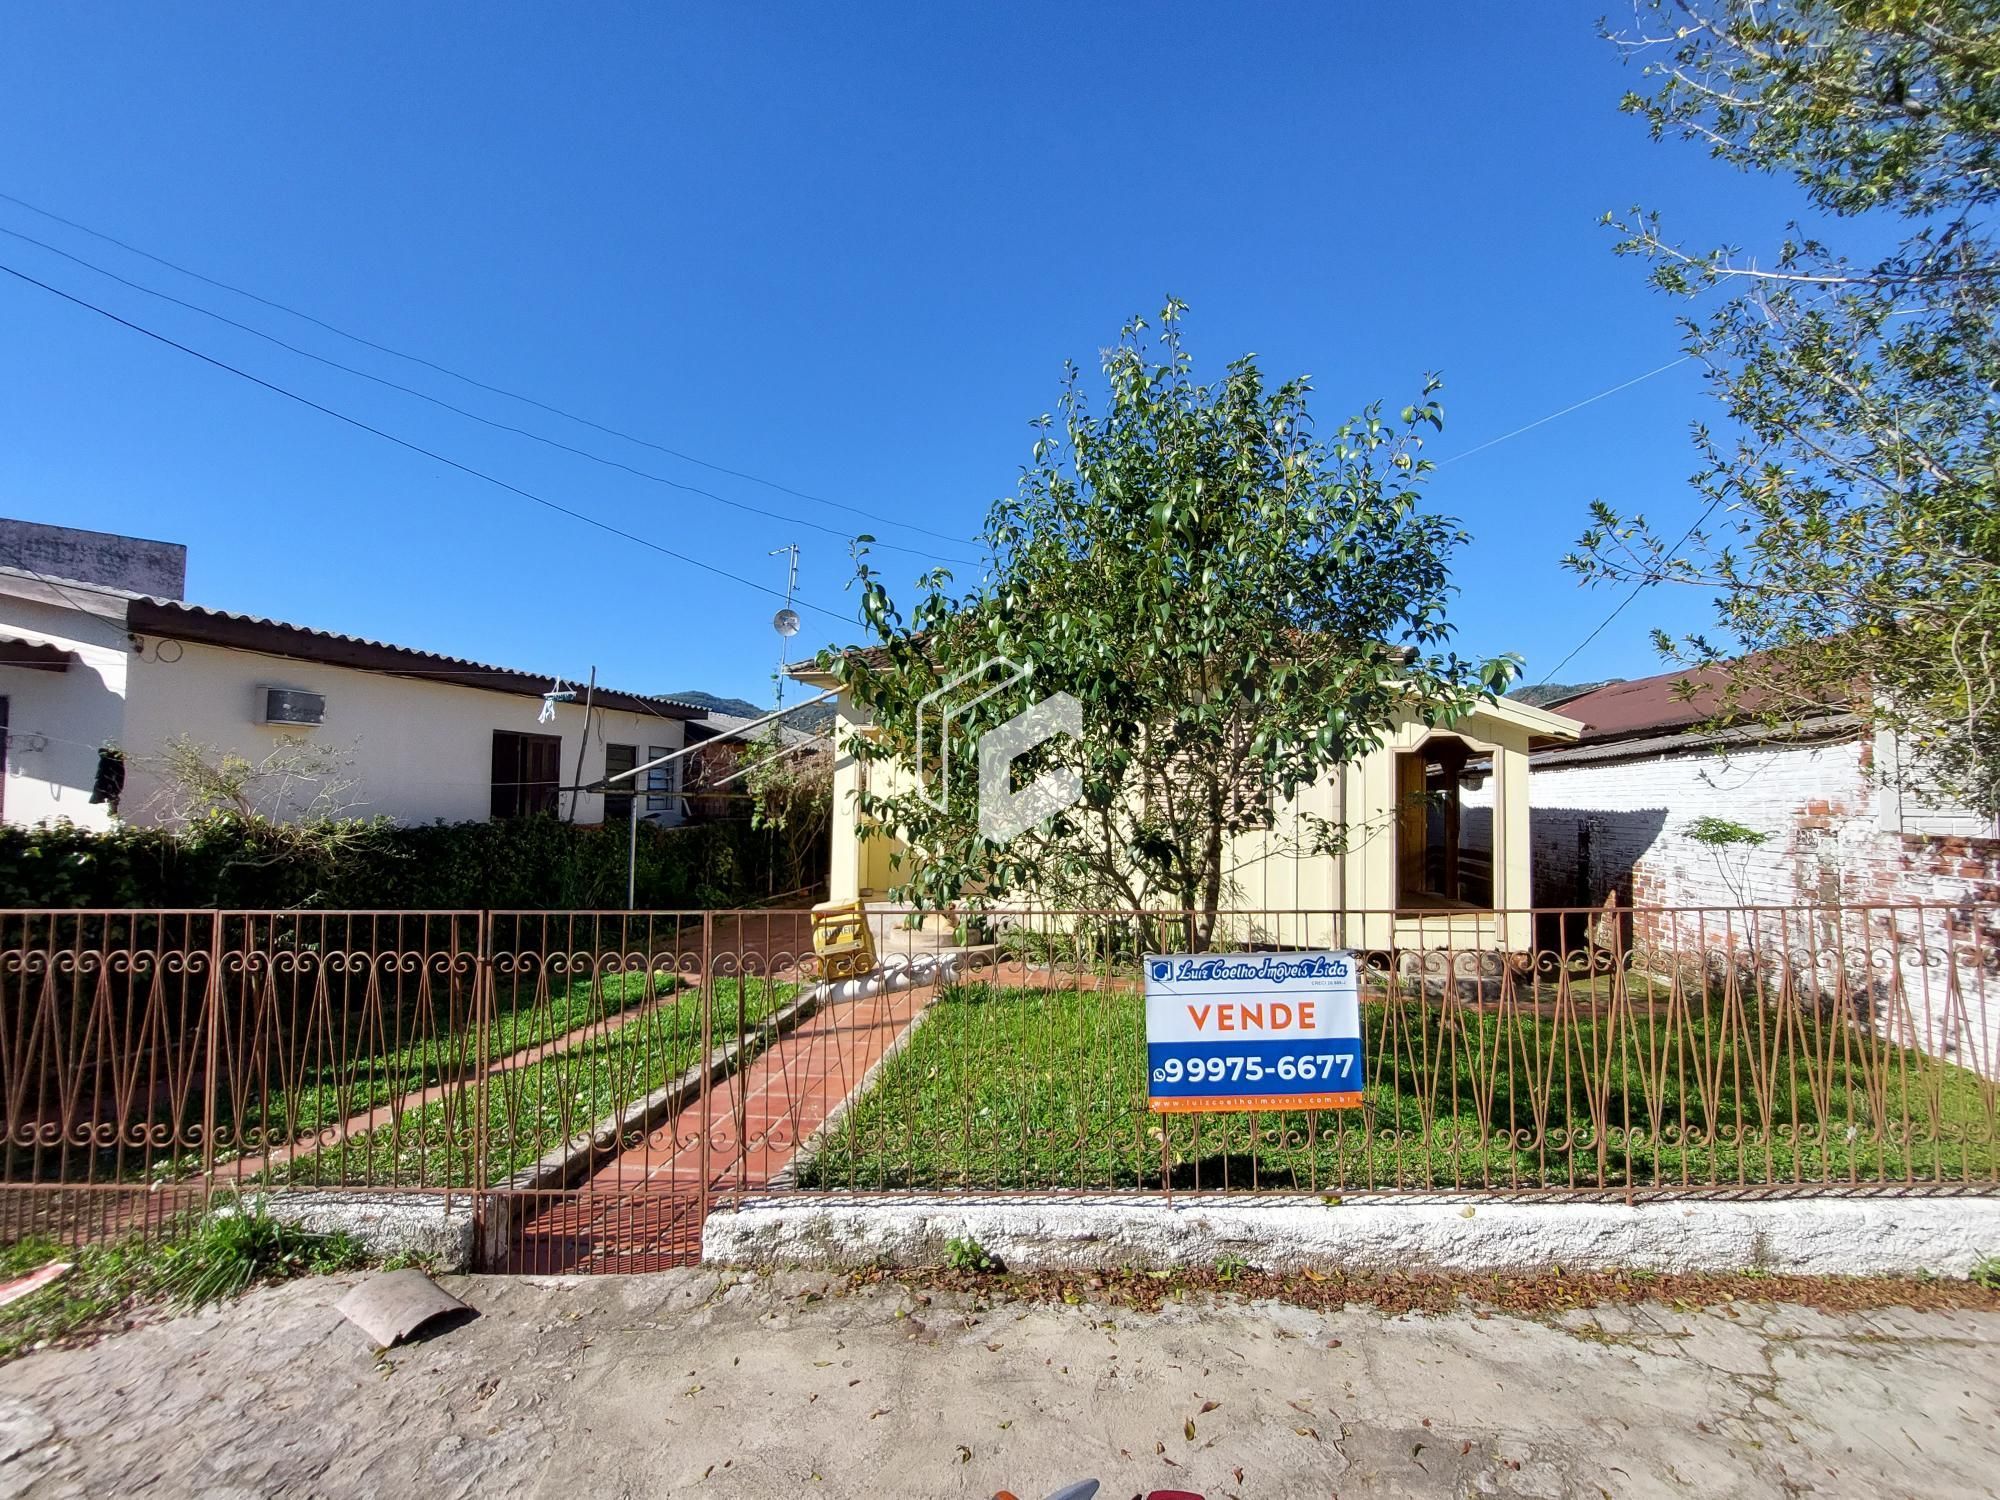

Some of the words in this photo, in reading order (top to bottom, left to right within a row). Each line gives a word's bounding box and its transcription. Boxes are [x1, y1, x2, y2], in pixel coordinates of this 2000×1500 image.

[1177, 961, 1208, 980] Luiz
[1201, 959, 1255, 979] Coelho
[1187, 1002, 1316, 1031] VENDE
[1164, 1054, 1354, 1083] 99975-6677
